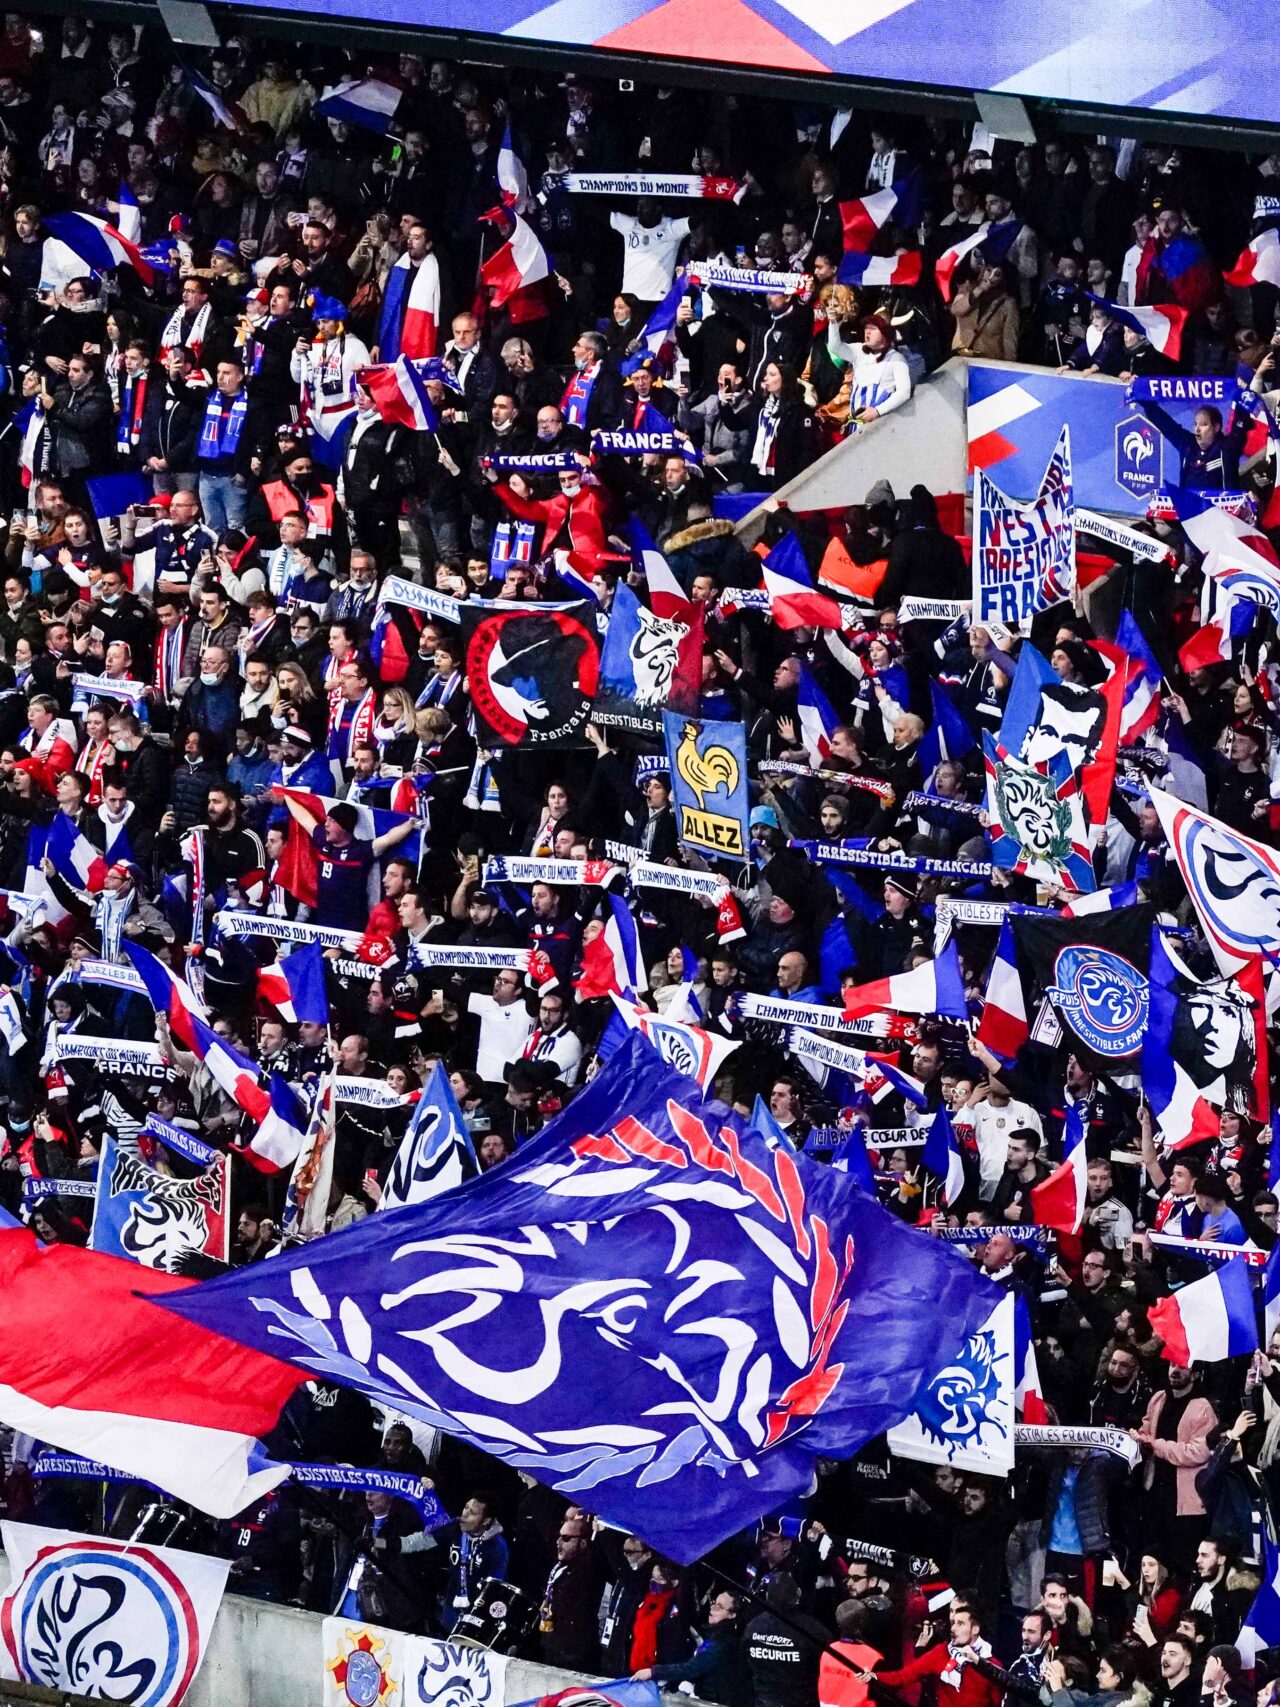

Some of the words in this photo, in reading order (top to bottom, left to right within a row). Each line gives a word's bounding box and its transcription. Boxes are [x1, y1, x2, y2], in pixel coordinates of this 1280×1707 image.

[579, 180, 637, 193] CHAMPIONS
[641, 182, 653, 194] DU
[657, 182, 690, 195] MONDE
[1150, 380, 1224, 400] FRANCE
[600, 432, 674, 450] FRANCE
[499, 453, 566, 467] FRANCE
[1123, 472, 1155, 484] FRANCE
[907, 603, 950, 617] CHAMPIONS
[530, 701, 592, 743] Français
[590, 711, 653, 730] IRRESISTIBLES
[685, 821, 740, 849] ALLEZ
[817, 844, 917, 868] IRRESISTIBLES
[322, 861, 333, 879] 19
[512, 863, 547, 880] CHAMPIONS
[547, 864, 556, 880] DU
[557, 865, 578, 881] MONDE
[637, 869, 680, 887] CHAMPIONS
[682, 876, 691, 889] DU
[230, 918, 290, 940] CHAMPIONS
[292, 926, 306, 941] DU
[309, 929, 346, 947] MONDE
[428, 950, 475, 965] CHAMPIONS
[476, 951, 487, 965] DU
[488, 953, 517, 967] MONDE
[108, 967, 126, 979] LES
[1049, 990, 1080, 1006] DEPUIS
[756, 1004, 819, 1027] CHAMPIONS
[821, 1013, 835, 1028] DU
[838, 1016, 875, 1034] MONDE
[1071, 1009, 1124, 1050] IRRESISTIBLES
[798, 1036, 835, 1060] CHAMPIONS
[835, 1049, 843, 1064] DU
[844, 1053, 863, 1071] MONDE
[98, 1060, 177, 1083] FRANCE
[871, 1128, 907, 1144] CŒUR
[1063, 1429, 1115, 1447] FRANCAIS
[35, 1458, 106, 1477] RRESISTIBLES
[237, 1527, 251, 1547] 19
[750, 1647, 801, 1662] SECURITE
